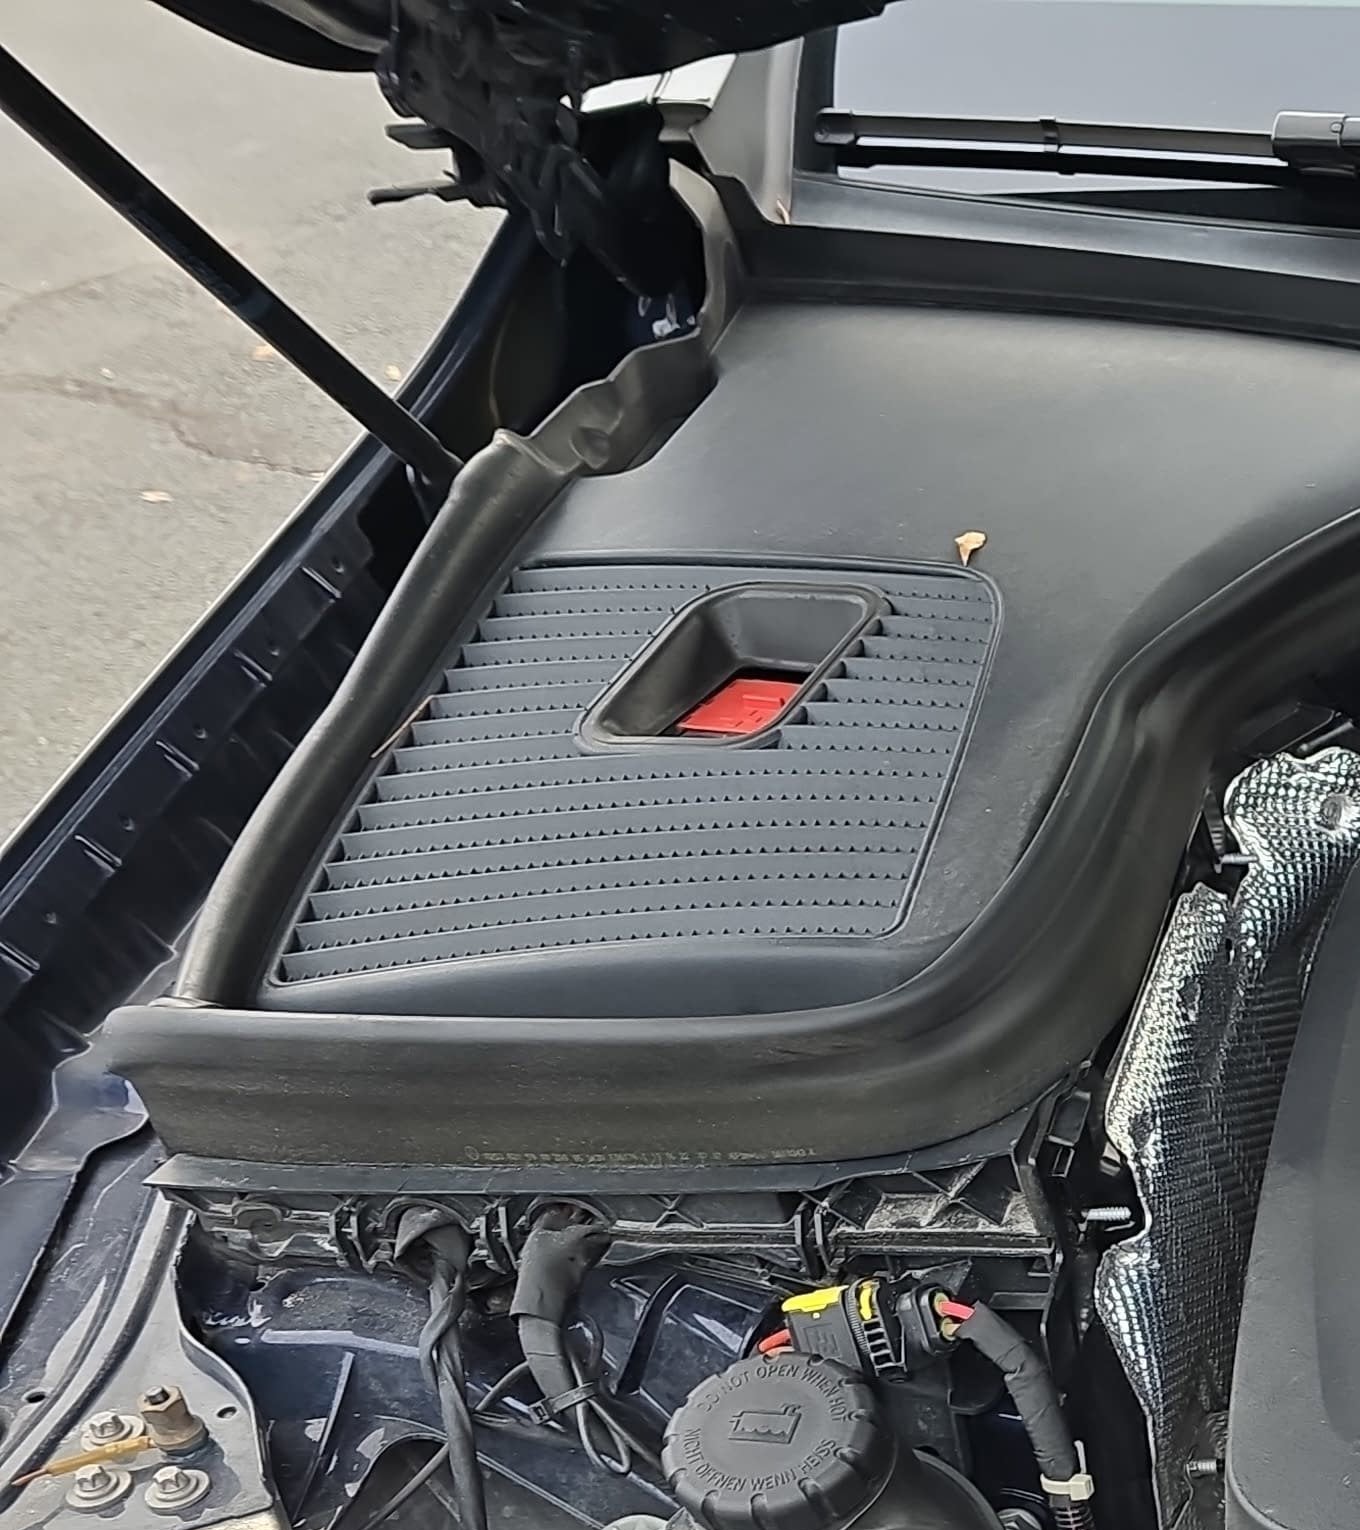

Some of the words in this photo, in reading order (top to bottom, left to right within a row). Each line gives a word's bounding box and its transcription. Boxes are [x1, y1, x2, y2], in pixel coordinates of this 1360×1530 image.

[697, 1391, 720, 1412] DO
[721, 1371, 750, 1394] NOT
[756, 1364, 800, 1379] OPEN
[800, 1367, 839, 1398] WHEN
[829, 1395, 852, 1423] HOT
[683, 1427, 705, 1466] NICHT
[750, 1467, 798, 1492] WENN
